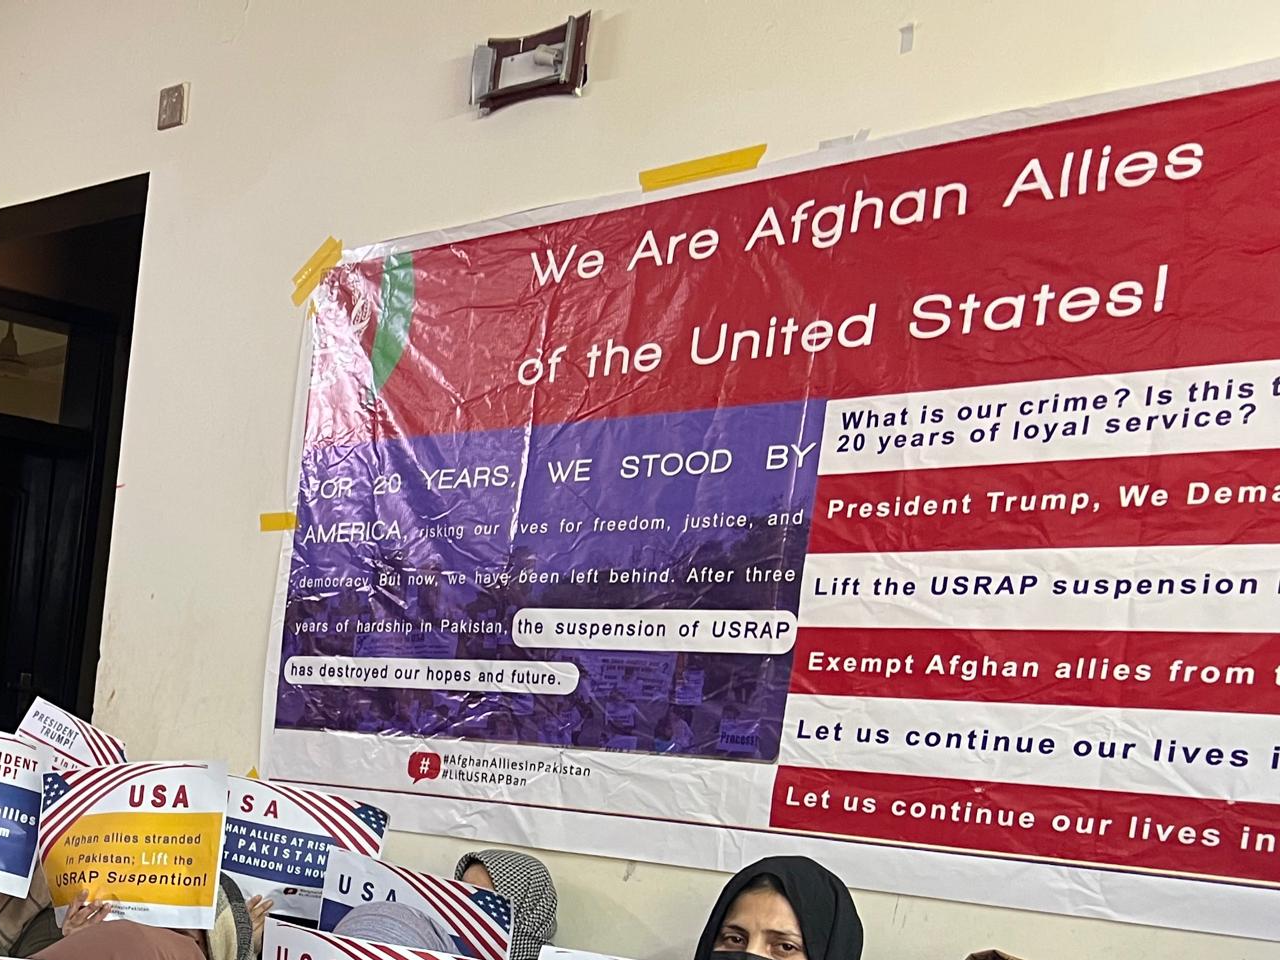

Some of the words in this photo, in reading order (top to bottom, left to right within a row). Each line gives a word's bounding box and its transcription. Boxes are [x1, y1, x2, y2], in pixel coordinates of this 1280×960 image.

[530, 245, 606, 287] We
[627, 229, 720, 271] Are
[745, 182, 968, 250] Afghan
[1002, 142, 1204, 208] Allies
[517, 345, 562, 387] of
[586, 339, 663, 379] the
[689, 303, 877, 367] United
[909, 264, 1169, 339] States!
[841, 410, 908, 430] What
[919, 405, 944, 424] is
[957, 400, 1007, 421] our
[1019, 389, 1130, 416] crime?
[1145, 385, 1171, 407] Is
[1188, 379, 1254, 402] this
[837, 433, 865, 453] 20
[877, 429, 955, 454] years
[970, 425, 999, 444] of
[1013, 416, 1089, 443] loyal
[1104, 403, 1256, 433] service?
[373, 474, 401, 495] 20
[422, 465, 516, 492] YEARS,
[548, 459, 593, 483] WE
[621, 450, 733, 479] STOOD
[766, 443, 816, 470] BY
[827, 497, 971, 519] President
[987, 492, 1100, 514] Trump,
[1119, 485, 1169, 508] We
[303, 521, 408, 545] AMERICA,
[419, 523, 463, 540] risking
[474, 523, 500, 536] our
[559, 518, 583, 534] for
[593, 515, 671, 534] freedom,
[684, 512, 753, 532] justice,
[767, 510, 803, 526] and
[379, 573, 402, 588] But
[409, 573, 439, 588] now,
[448, 573, 466, 586] we
[475, 572, 510, 587] have
[518, 570, 559, 585] been
[571, 568, 598, 584] left
[609, 567, 675, 584] behind.
[686, 567, 734, 584] After
[745, 567, 796, 582] three
[815, 577, 860, 596] Lift
[873, 577, 916, 596] the
[931, 575, 1038, 596] USRAP
[1052, 575, 1258, 599] suspension
[294, 618, 328, 635] years
[336, 618, 350, 633] of
[356, 618, 412, 637] hardship
[421, 619, 432, 633] in
[440, 618, 507, 637] Pakistan,
[517, 619, 544, 635] the
[555, 619, 666, 640] suspension
[678, 619, 700, 637] of
[712, 620, 790, 639] USRAP
[291, 664, 313, 679] has
[320, 664, 388, 683] destroyed
[394, 668, 419, 681] our
[426, 668, 471, 686] hopes
[478, 669, 504, 684] and
[510, 668, 561, 686] future.
[808, 652, 914, 678] Exempt
[926, 654, 1039, 681] Afghan
[1054, 657, 1152, 681] allies
[1169, 659, 1255, 685] from
[33, 710, 79, 741] PRESIDENT
[797, 720, 842, 741] Let
[857, 725, 890, 744] us
[905, 728, 1055, 755] continue
[1073, 737, 1136, 760] our
[1154, 739, 1249, 767] lives
[441, 768, 527, 786] #LiftUSRAPBan
[442, 753, 591, 777] #AfghanAlliesInPakistan
[129, 784, 189, 808] USA
[64, 834, 99, 847] Afghan
[104, 833, 138, 843] allies
[145, 834, 201, 845] stranded
[250, 828, 287, 844] ALLIES
[291, 837, 304, 847] AT
[78, 853, 135, 865] Pakistan;
[142, 852, 168, 864] Lift
[174, 856, 193, 865] the
[232, 853, 283, 871] ABANDON
[287, 865, 301, 874] US
[237, 839, 326, 864] PAKISTAN
[56, 871, 99, 887] USRAP
[107, 872, 207, 886] Suspention!
